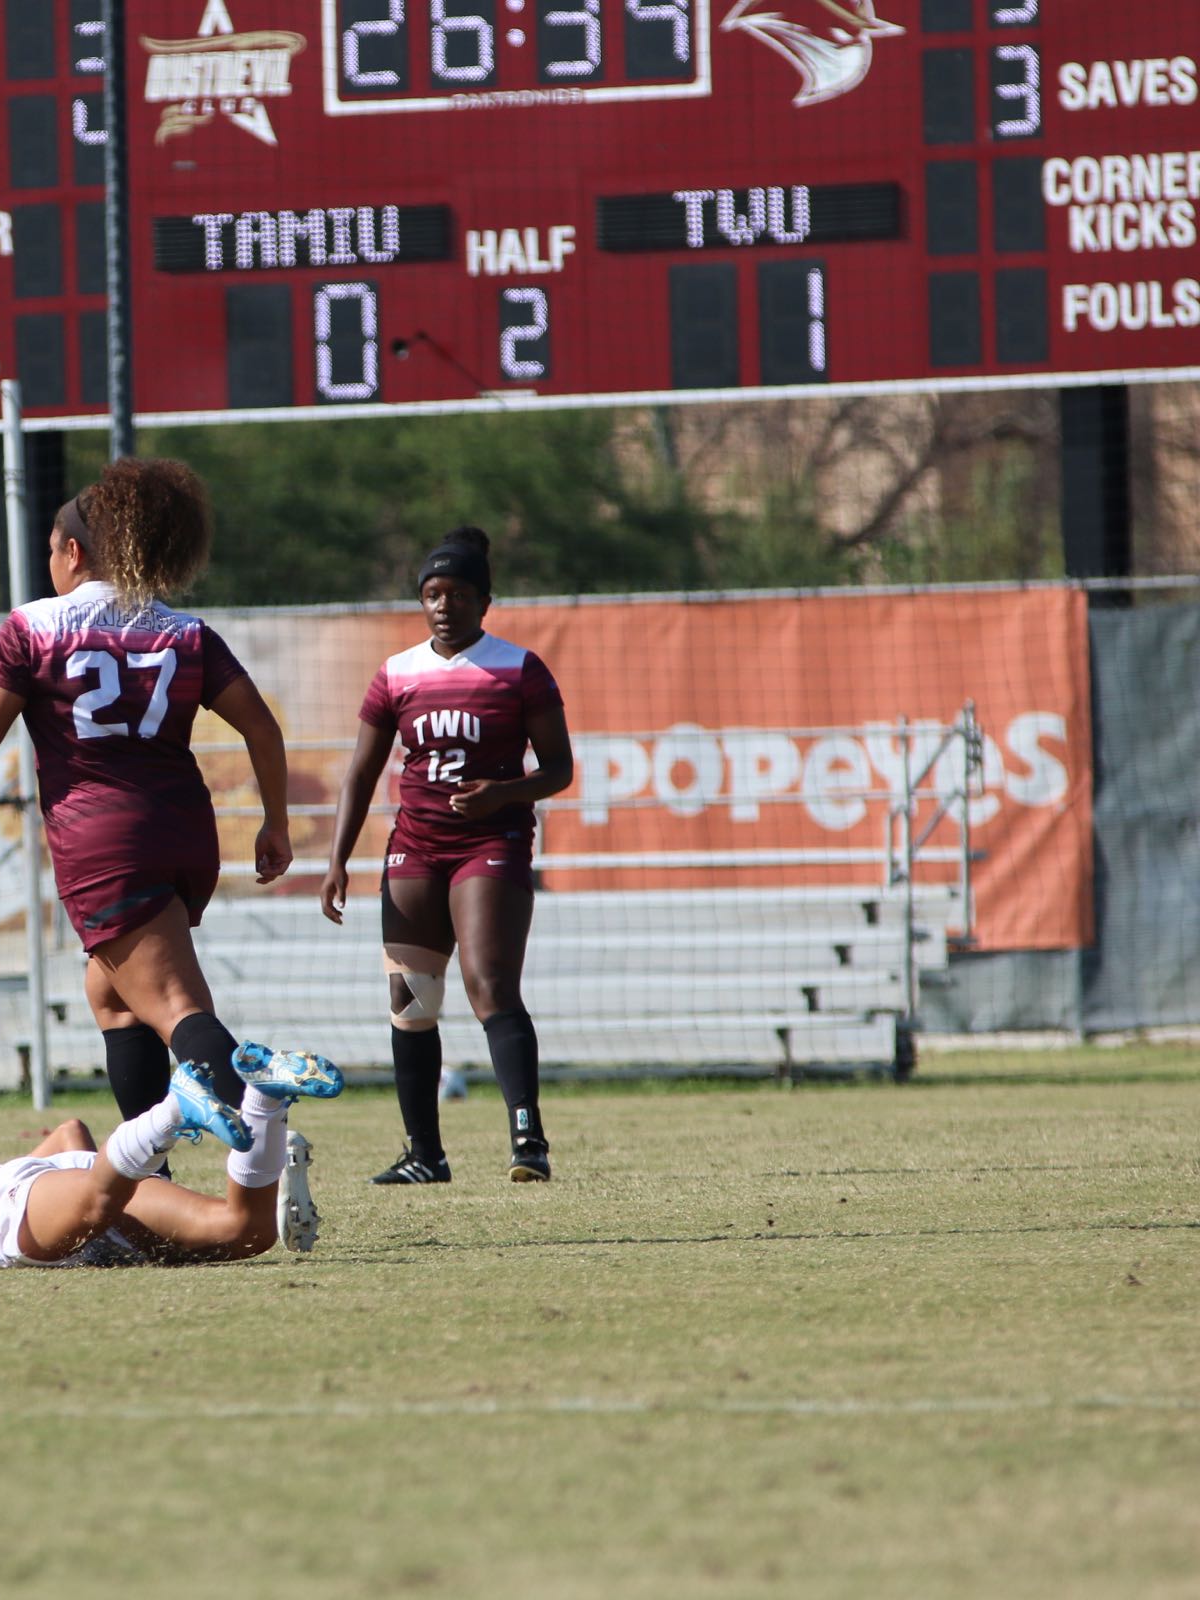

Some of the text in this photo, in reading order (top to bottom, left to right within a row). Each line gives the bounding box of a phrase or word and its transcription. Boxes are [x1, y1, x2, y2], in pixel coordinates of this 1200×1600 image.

[997, 44, 1041, 135] 3
[1058, 56, 1198, 111] SAVES
[192, 205, 400, 270] TAMIU
[673, 185, 811, 247] TWU
[1068, 199, 1196, 253] KICKS
[465, 225, 576, 277] HALF
[500, 287, 548, 379] 2
[807, 267, 826, 371] 1
[1062, 278, 1200, 333] FOULS
[315, 282, 378, 399] 0
[66, 648, 177, 739] 27
[413, 710, 480, 746] TWU
[427, 748, 466, 783] 12
